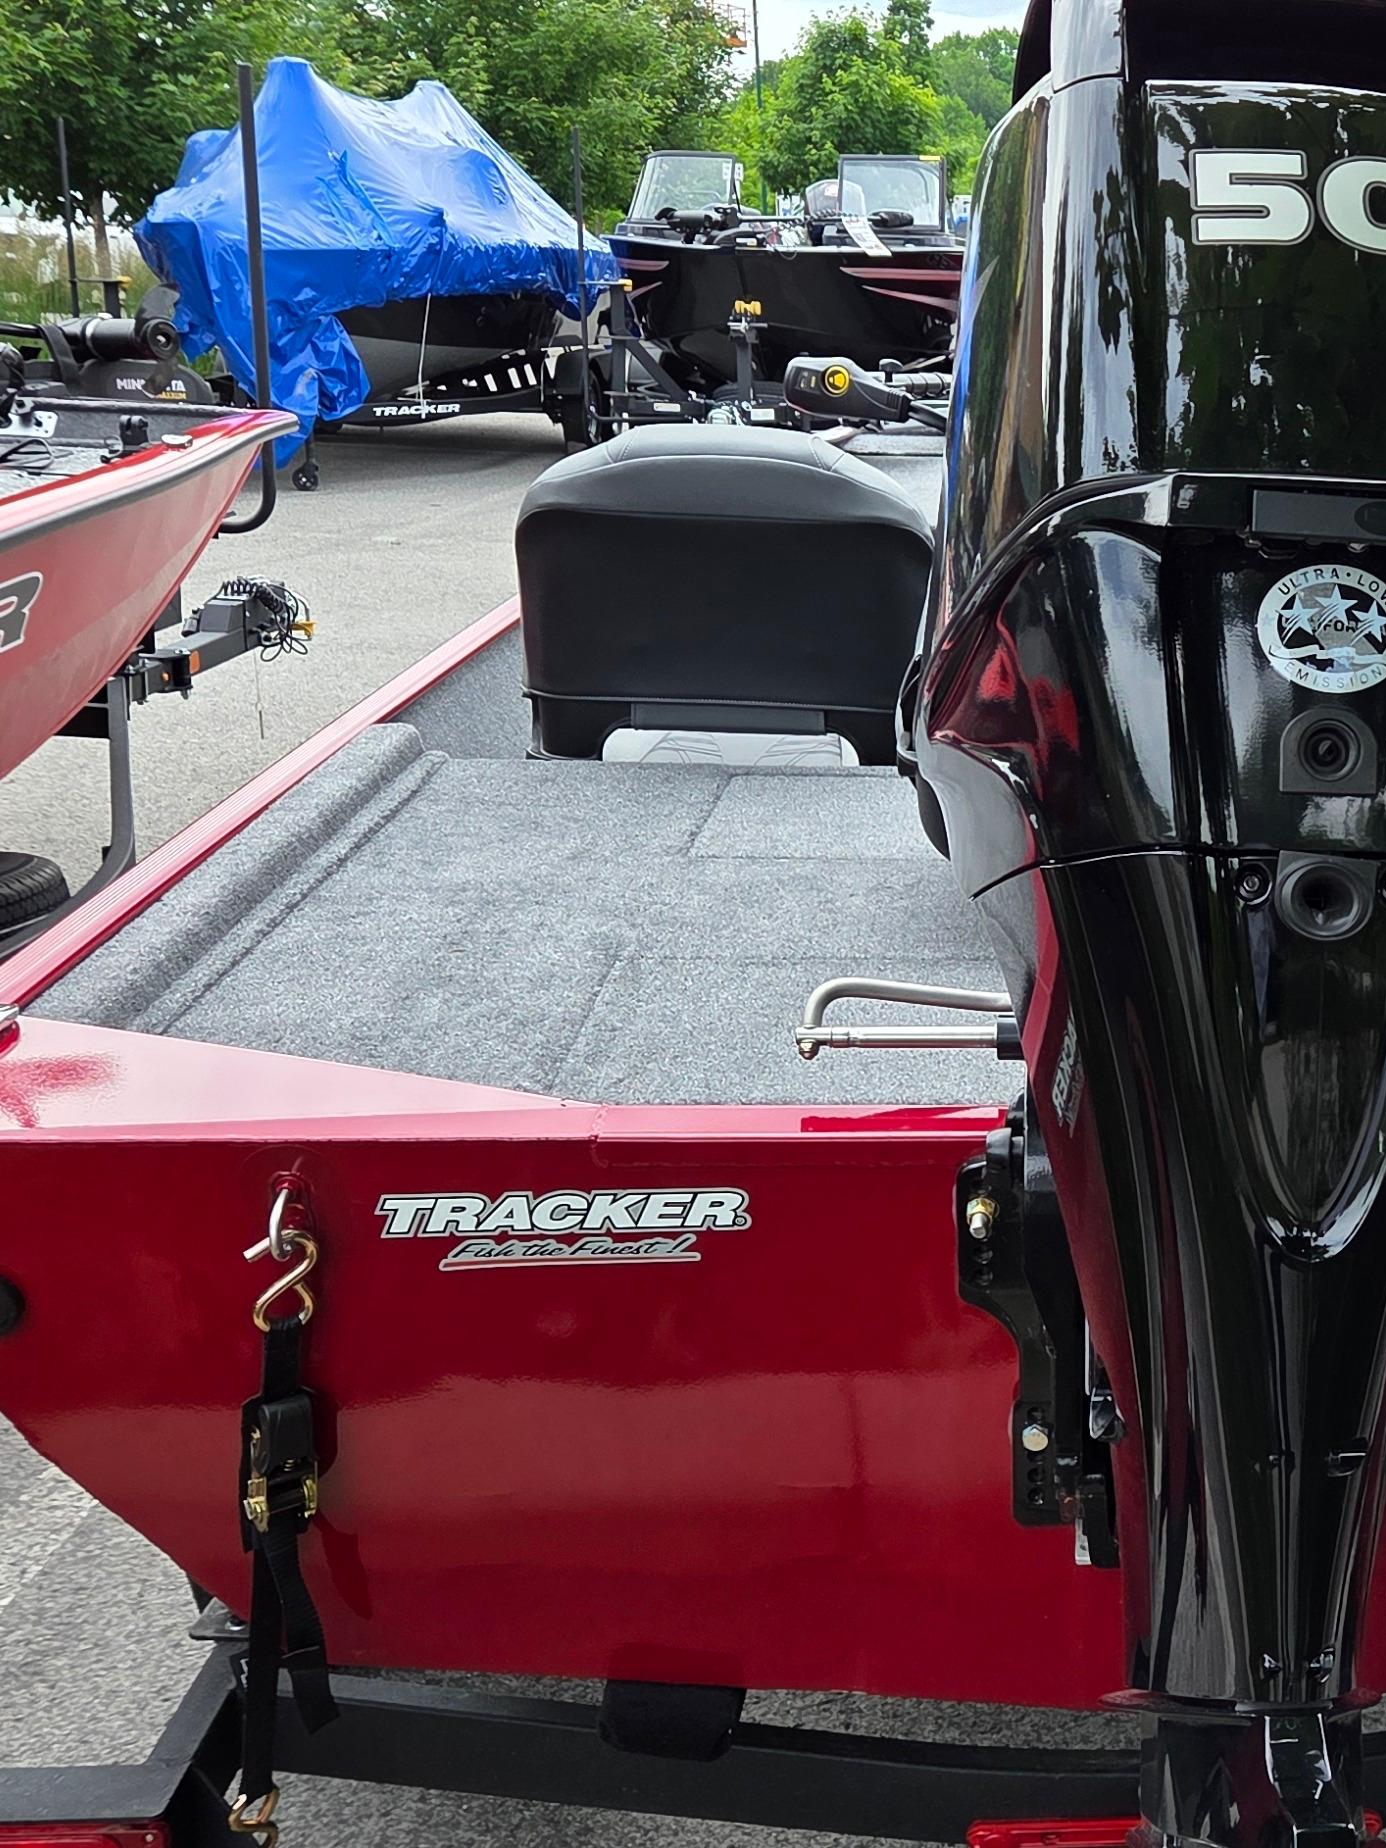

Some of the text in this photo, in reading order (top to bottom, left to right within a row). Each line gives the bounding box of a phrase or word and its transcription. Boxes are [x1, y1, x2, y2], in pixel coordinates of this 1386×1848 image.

[372, 403, 461, 417] TRACKER
[1278, 567, 1340, 596] ULTRA
[452, 1242, 518, 1259] Fish
[521, 1240, 566, 1258] the
